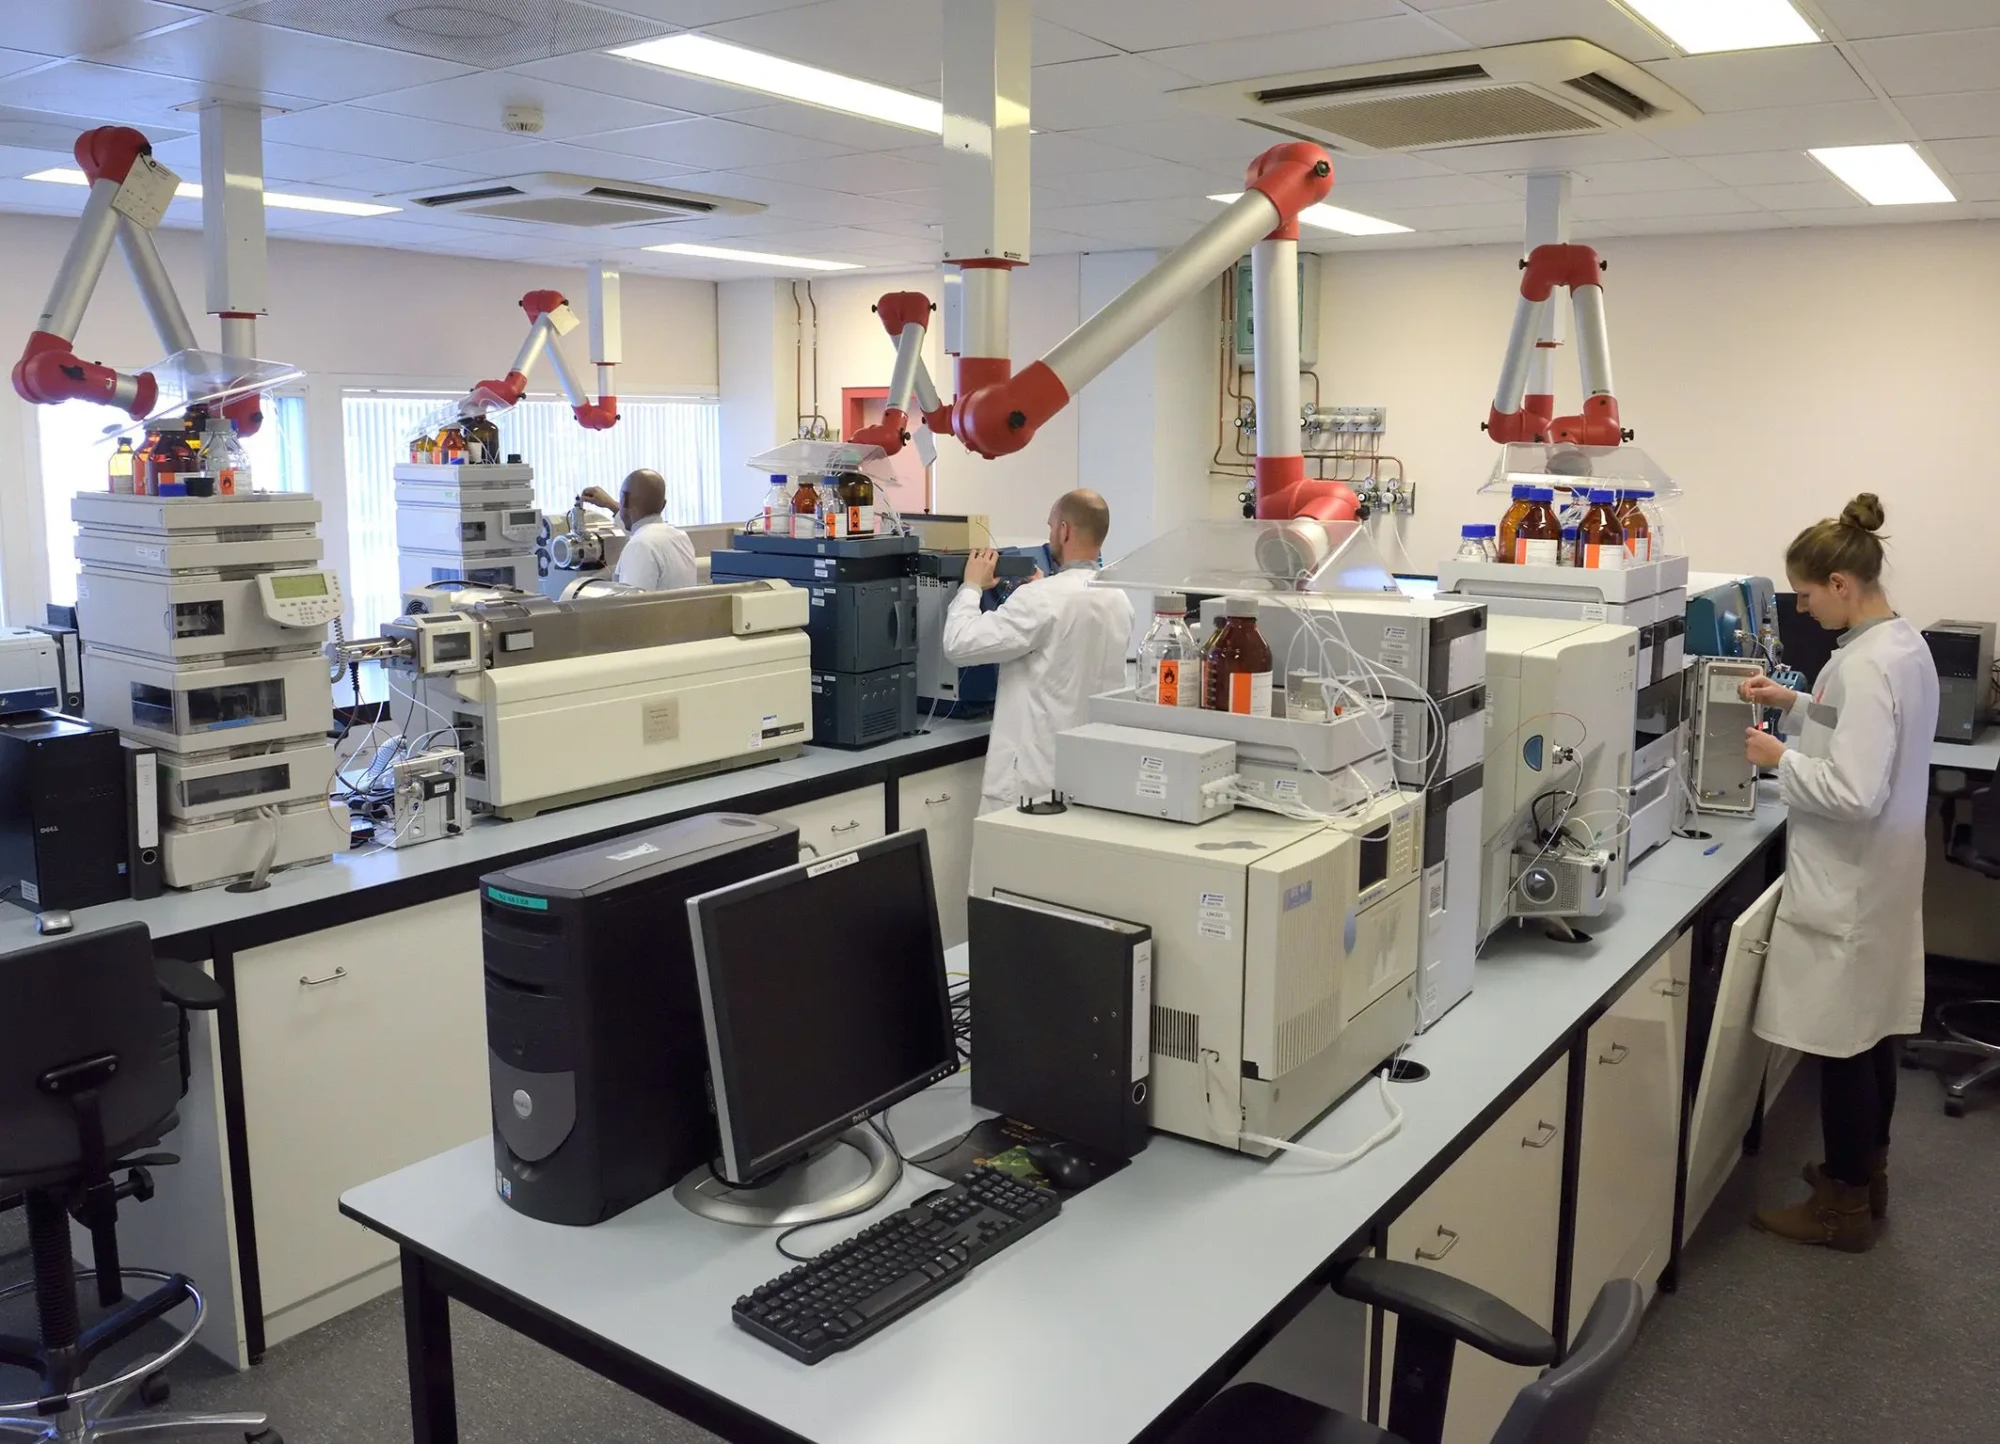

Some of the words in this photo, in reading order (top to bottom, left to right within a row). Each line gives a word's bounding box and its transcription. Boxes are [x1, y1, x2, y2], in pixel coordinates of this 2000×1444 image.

[40, 825, 59, 834] DELL
[852, 1109, 870, 1124] DELL
[927, 1196, 947, 1208] DELL
